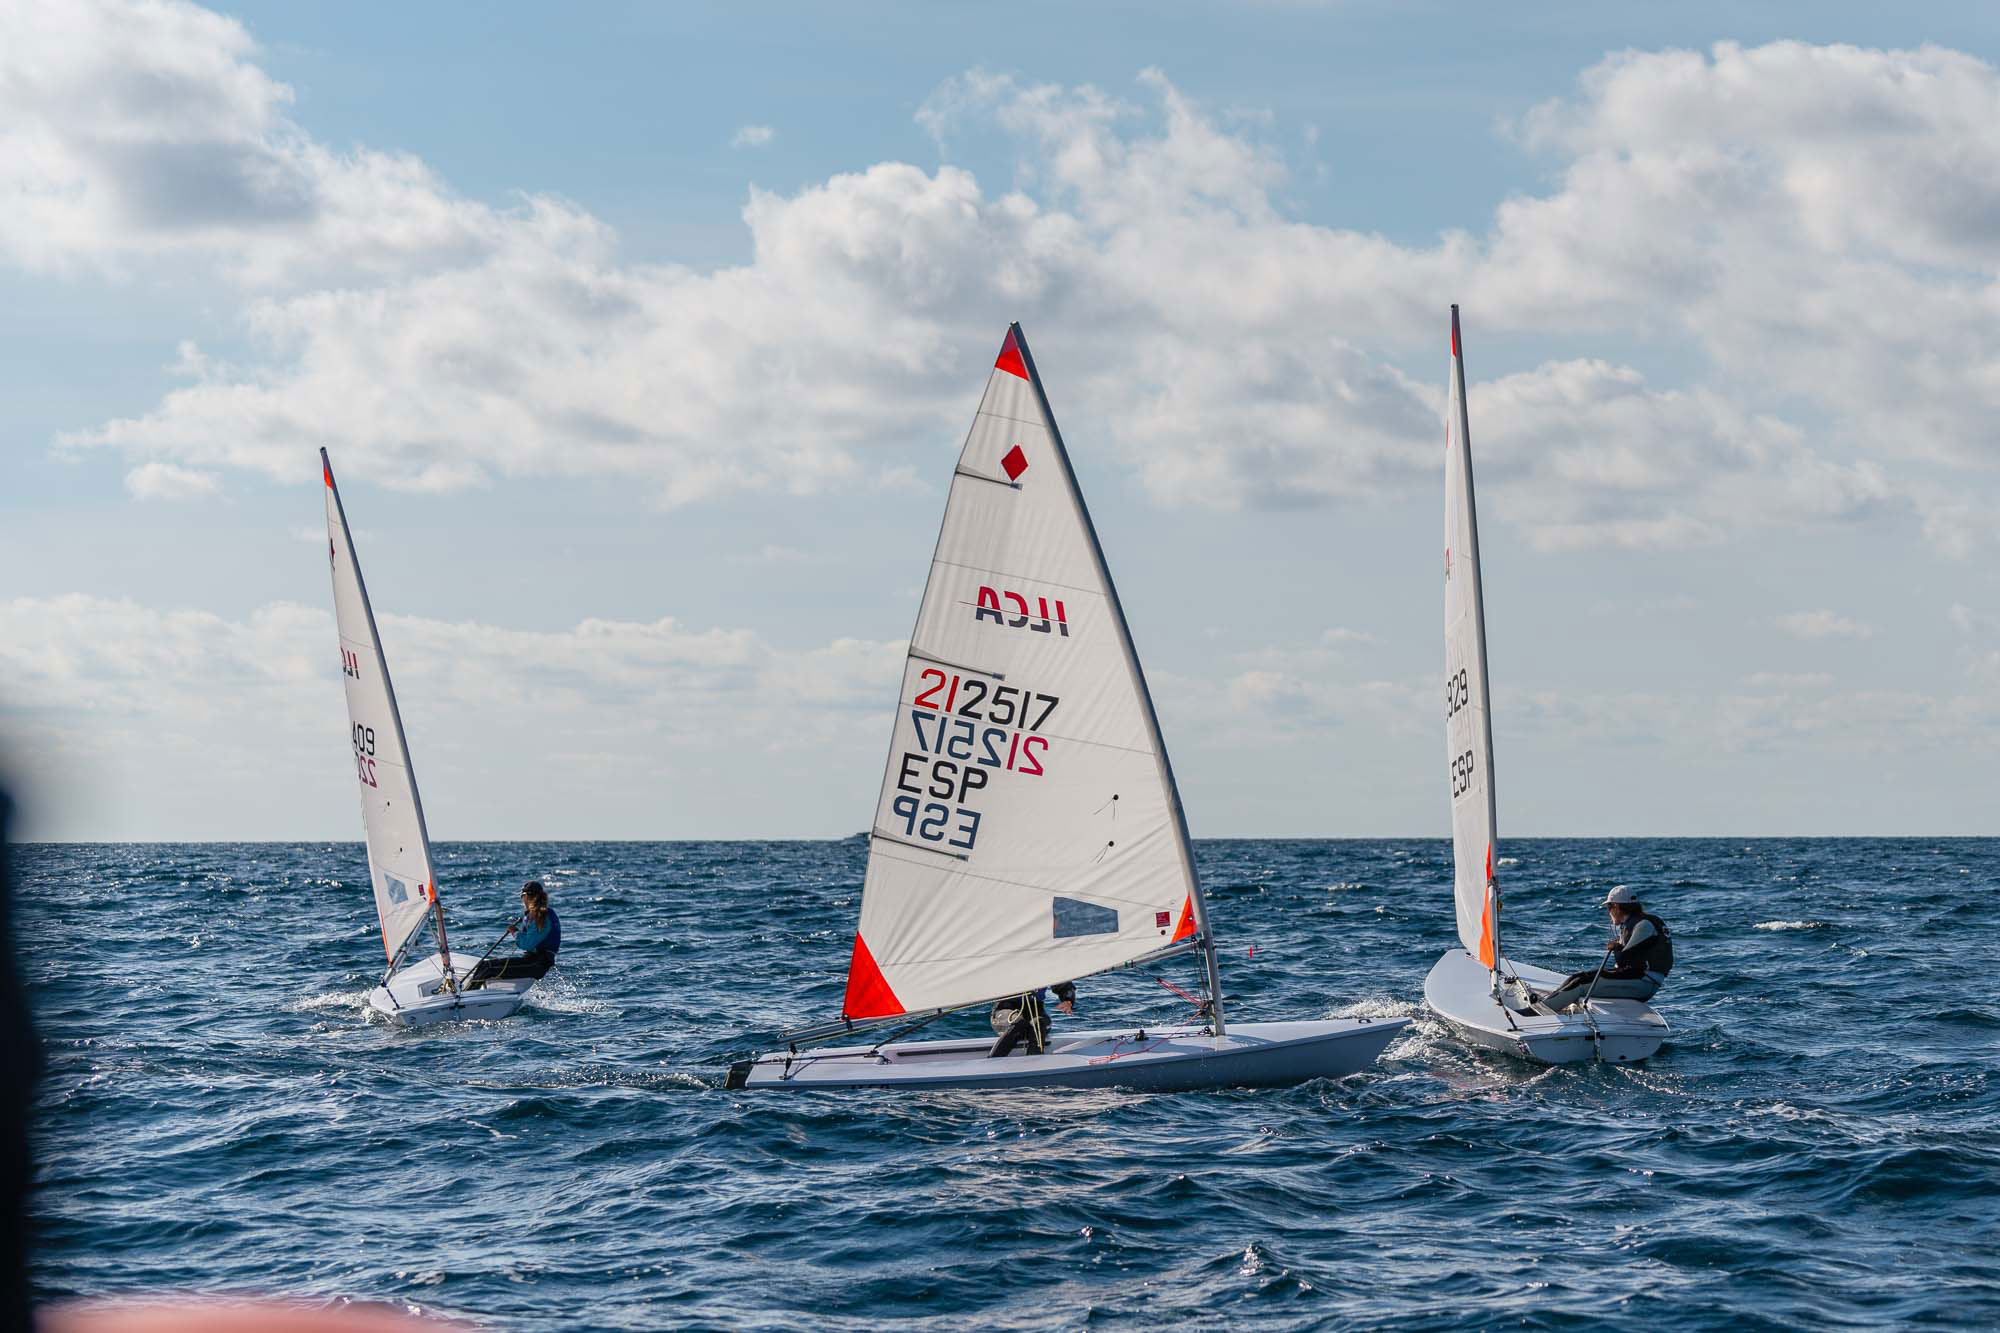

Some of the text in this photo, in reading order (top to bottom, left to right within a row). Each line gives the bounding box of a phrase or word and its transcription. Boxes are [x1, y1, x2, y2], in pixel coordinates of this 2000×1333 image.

[914, 668, 1060, 731] 212517
[897, 752, 988, 803] ESP
[1452, 749, 1474, 799] ESP
